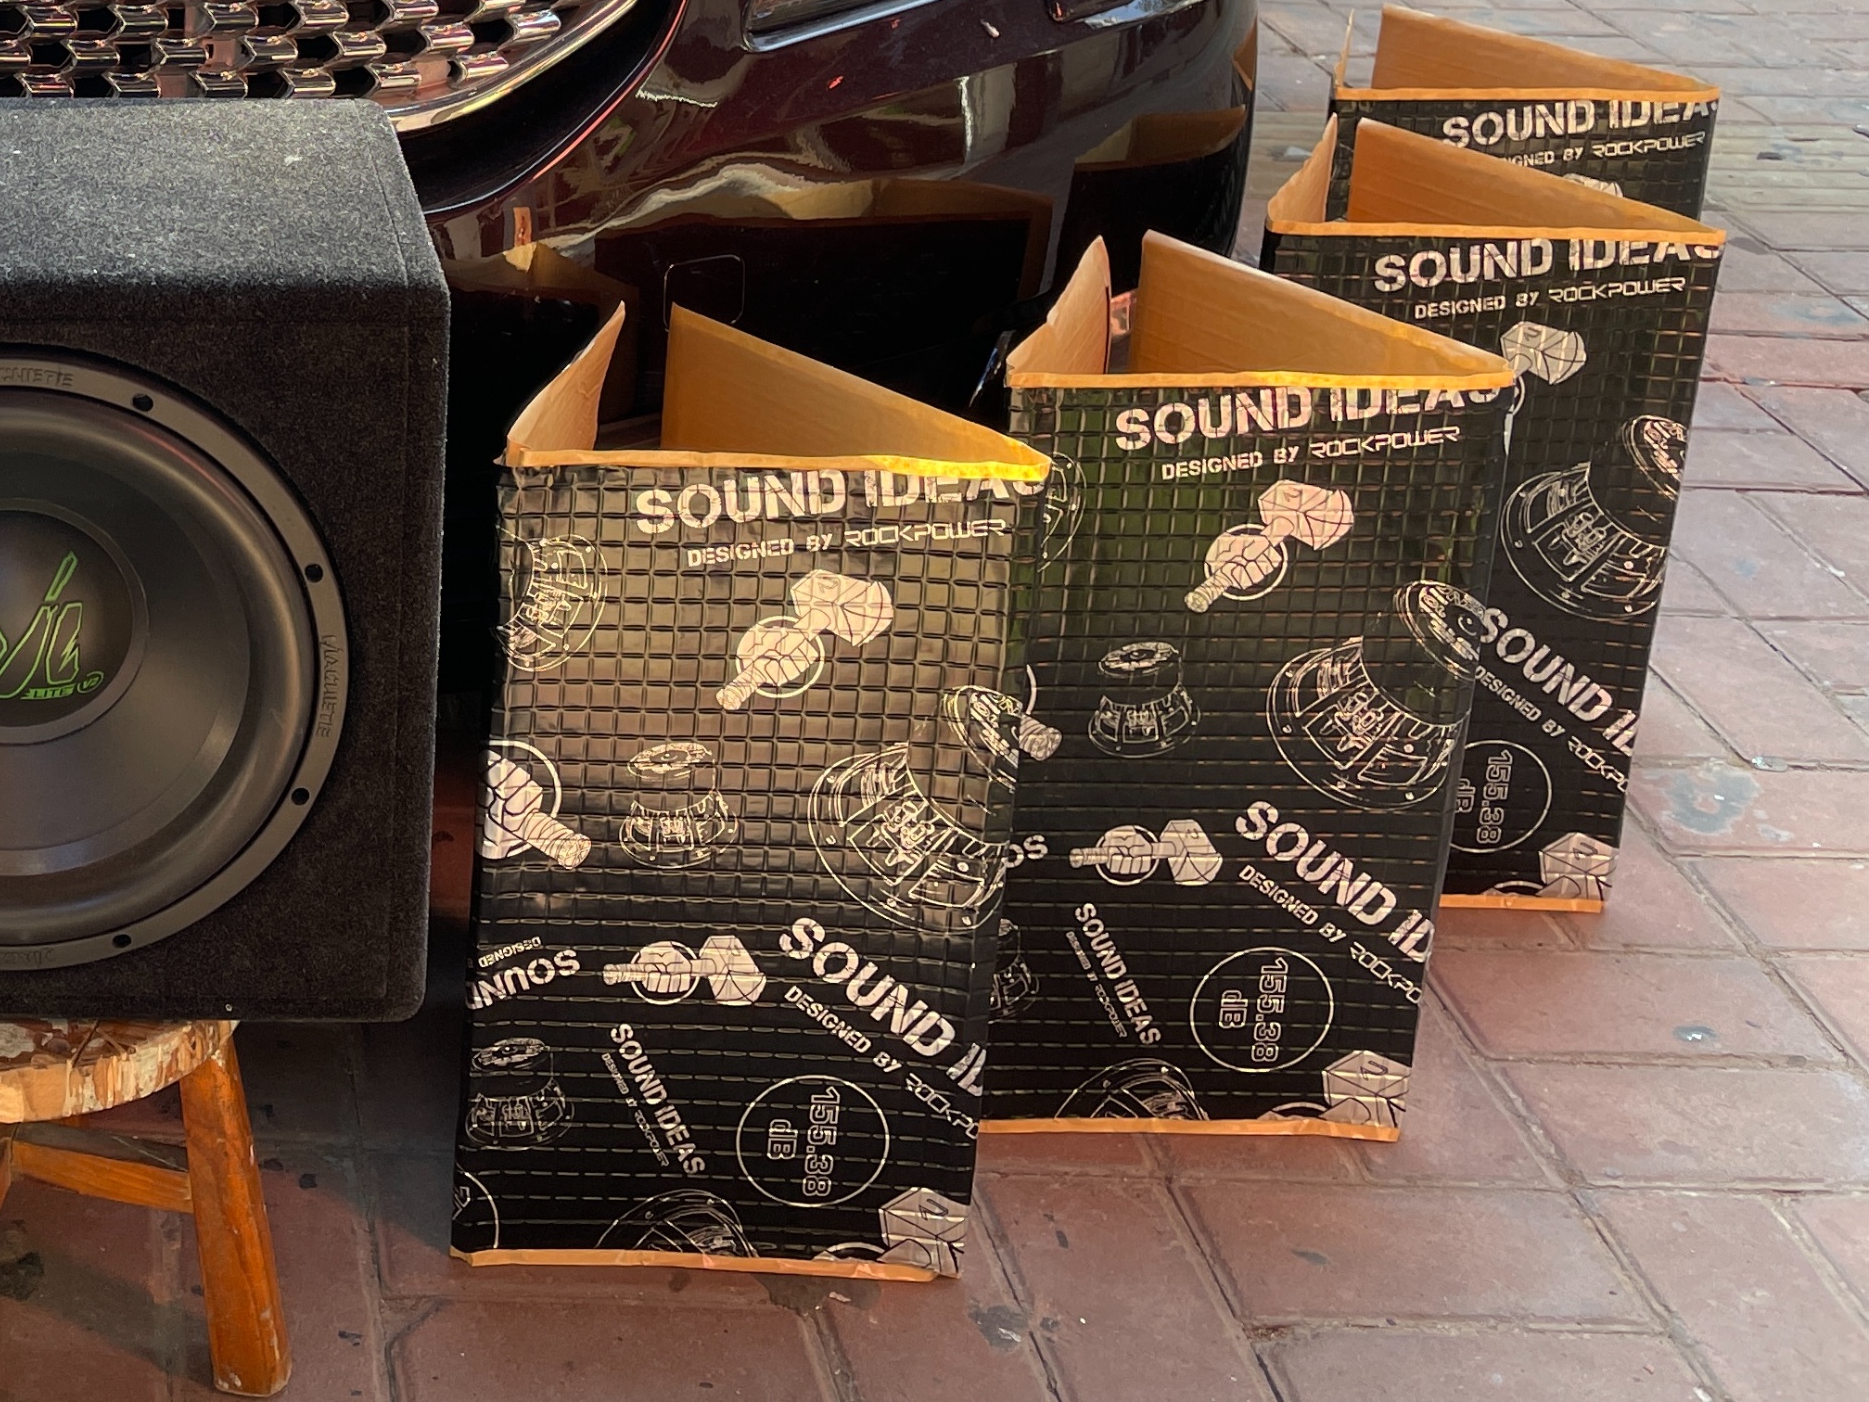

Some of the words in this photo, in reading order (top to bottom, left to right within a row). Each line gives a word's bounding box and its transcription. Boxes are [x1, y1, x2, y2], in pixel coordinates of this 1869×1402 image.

[1442, 100, 1596, 149] SOUND
[1608, 99, 1718, 129] IDEA
[1563, 147, 1583, 161] BY
[1592, 131, 1707, 158] ROCKPOWER
[1374, 238, 1554, 293] SOUND
[1414, 296, 1507, 320] DESIGNED
[1515, 292, 1539, 308] BY
[1548, 276, 1686, 304] ROCKPOWER
[1115, 387, 1314, 451] SOUND
[1161, 450, 1264, 481] DESIGNED
[1274, 445, 1300, 465] BY
[1309, 426, 1461, 460] ROCKPOWER
[635, 470, 847, 534] SOUND
[686, 537, 795, 568] DESIGNED
[805, 533, 833, 554] BY
[843, 518, 1007, 548] ROCKPOWER
[1479, 607, 1614, 722] SOUND
[1475, 665, 1543, 722] DESIGNED
[1541, 719, 1566, 738] BY
[1476, 749, 1514, 844] 155.38
[1235, 800, 1398, 926] SOUND
[1238, 864, 1320, 926] DESIGNED
[1319, 922, 1347, 943] BY
[478, 936, 542, 969] DESIGNED
[1074, 902, 1128, 980] SOUND
[1114, 979, 1162, 1045] IDEAS
[779, 917, 956, 1057] SOUND
[1218, 989, 1249, 1030] dB
[1251, 957, 1289, 1063] 155.38
[784, 985, 873, 1053] DESIGNED
[873, 1051, 902, 1073] BY
[610, 1023, 668, 1105] SOUND
[653, 1104, 706, 1174] IDEAS
[767, 1119, 798, 1161] dB
[802, 1086, 841, 1198] 155.38
